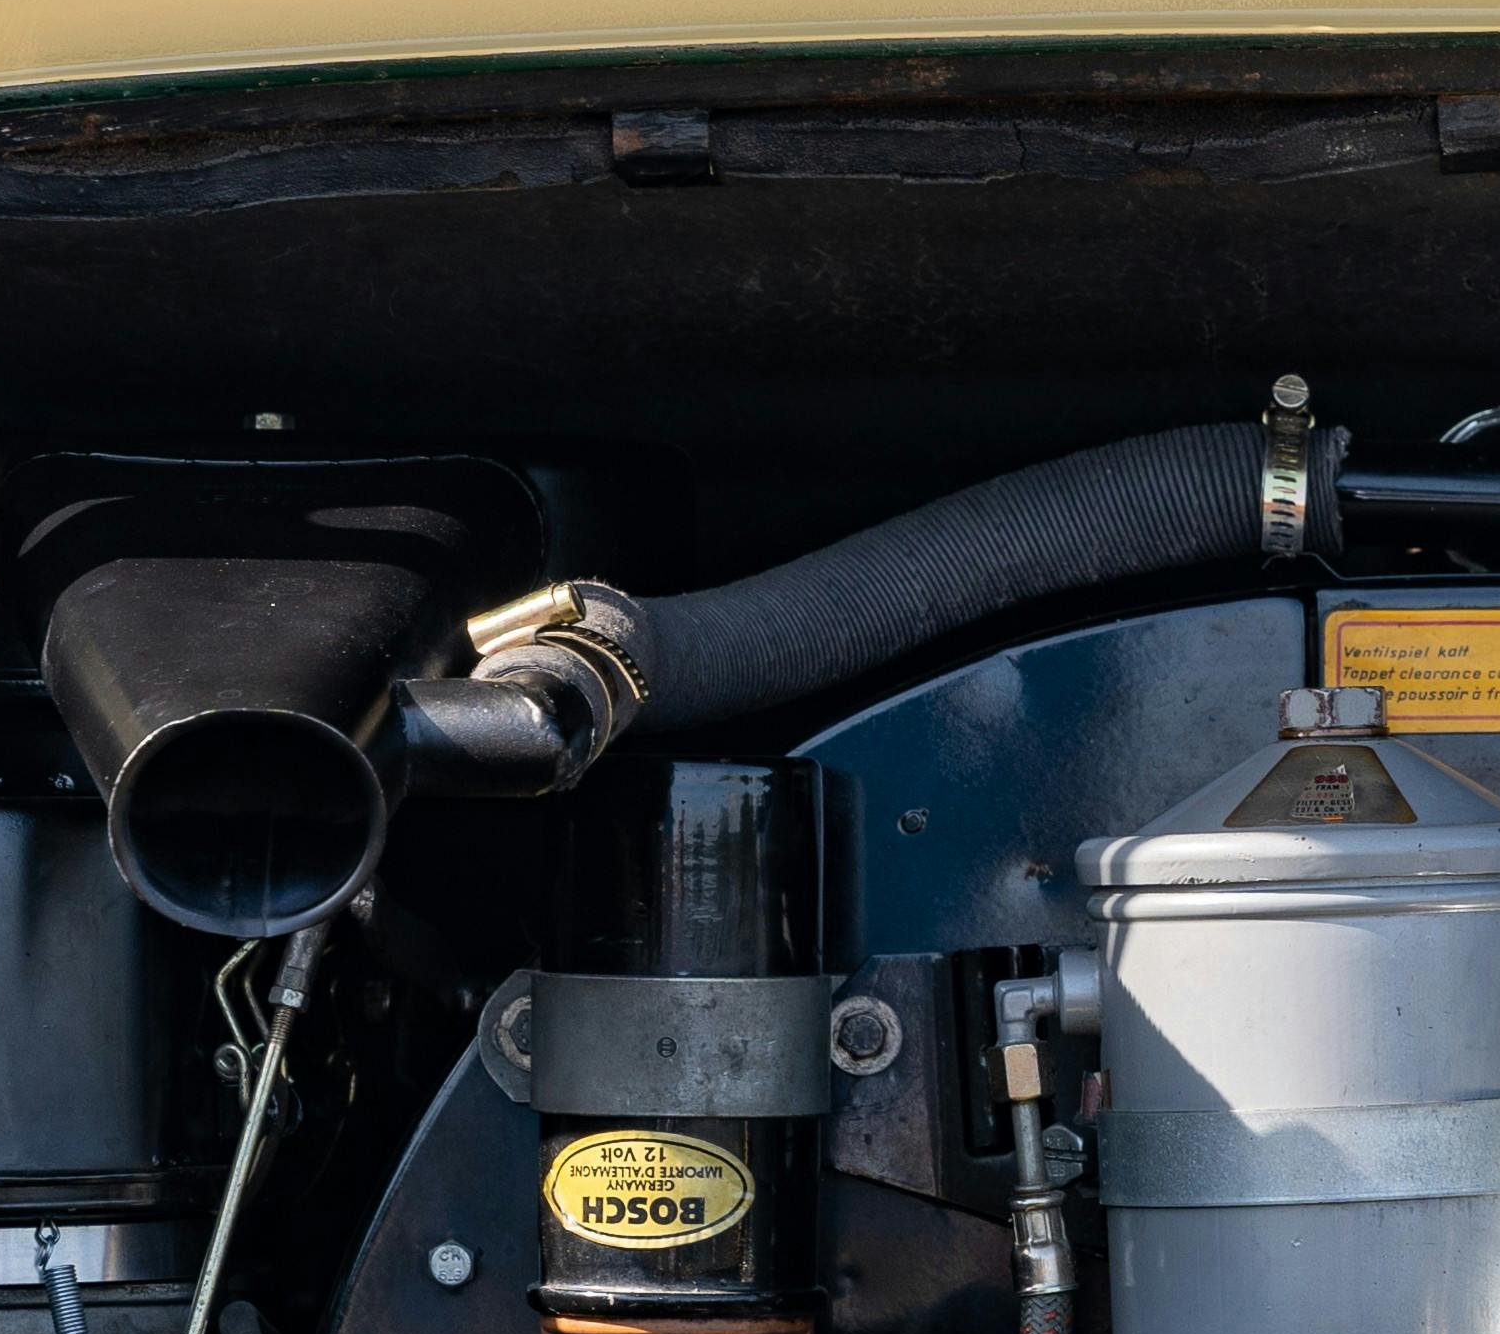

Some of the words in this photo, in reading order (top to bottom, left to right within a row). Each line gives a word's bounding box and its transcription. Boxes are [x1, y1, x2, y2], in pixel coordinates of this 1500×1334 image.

[1343, 645, 1430, 661] Ventilspiel
[1437, 644, 1470, 658] kalt
[1342, 666, 1396, 682] Tappet
[1399, 666, 1482, 680] clearance
[1396, 687, 1469, 703] poussoir
[1472, 686, 1482, 700] à
[600, 1146, 637, 1164] Volt
[644, 1146, 667, 1163] 12
[569, 1164, 655, 1180] D'ALLEMAGNE
[659, 1165, 723, 1180] IMPORTE
[606, 1179, 675, 1192] GERMANY
[582, 1196, 706, 1225] BOSCH
